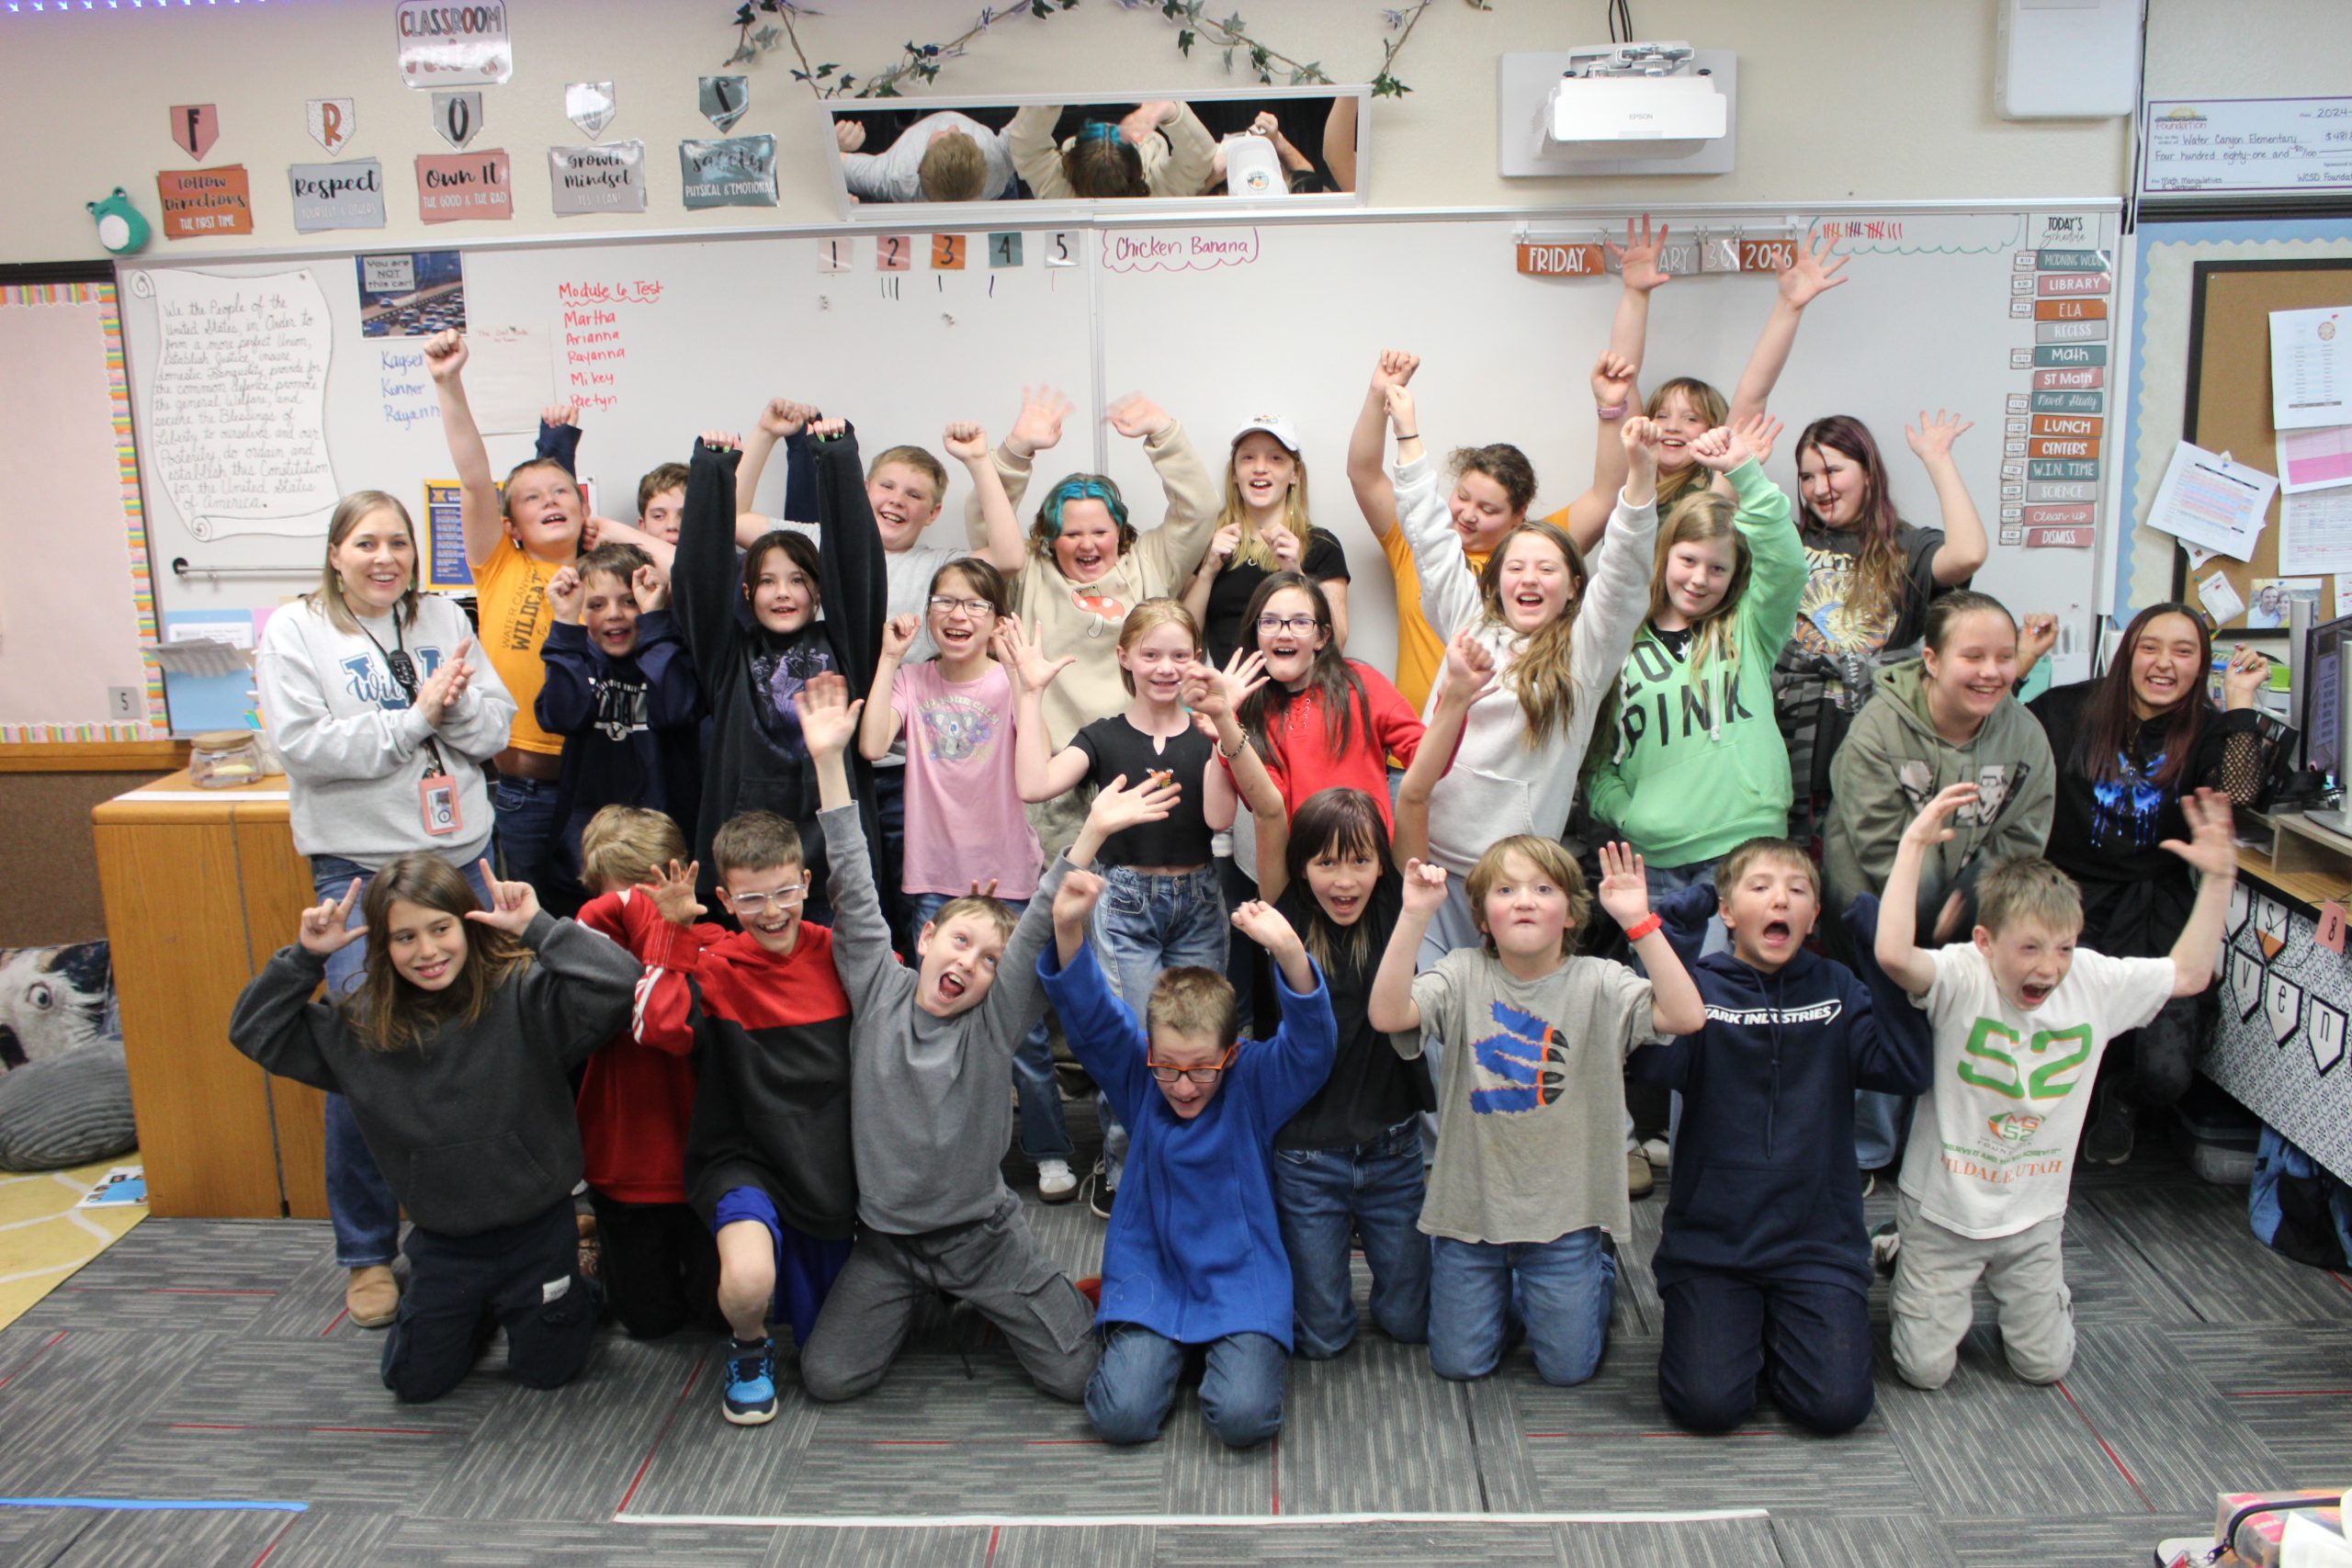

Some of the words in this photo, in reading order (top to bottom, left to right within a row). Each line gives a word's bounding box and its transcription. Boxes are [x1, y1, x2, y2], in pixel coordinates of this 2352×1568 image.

[401, 6, 502, 37] CLASSROOM
[187, 108, 200, 152] F
[322, 102, 342, 147] R
[2183, 134, 2209, 145] Water
[2215, 134, 2243, 149] Canyon
[2249, 133, 2297, 145] Elementary
[2155, 151, 2175, 161] Four
[2181, 150, 2215, 161] hundred
[2272, 150, 2290, 158] and
[294, 169, 380, 199] Respect
[426, 168, 476, 188] Own
[564, 169, 632, 189] Mindset
[2298, 173, 2320, 182] WCSD
[685, 184, 721, 197] PHYSICAL
[164, 192, 246, 212] Directions
[423, 196, 438, 209] THE
[441, 195, 461, 208] GOOD
[474, 193, 488, 206] THE
[491, 192, 506, 205] BAD
[180, 219, 195, 231] THE
[196, 216, 215, 230] FIRST
[218, 214, 235, 228] TIME
[2047, 217, 2084, 231] TODAY'S
[887, 238, 899, 266] 2
[942, 235, 954, 265] 3
[999, 236, 1011, 264] 4
[1057, 234, 1068, 260] 5
[1115, 236, 1182, 261] Chicken
[1191, 236, 1249, 255] Banana
[1529, 247, 1591, 273] FRIDAY,
[2044, 253, 2078, 266] MORNING
[378, 269, 401, 278] NOT
[368, 279, 388, 288] this
[559, 282, 609, 299] Module
[616, 282, 627, 296] 6
[633, 280, 663, 295] Test
[2049, 277, 2100, 290] LIBRARY
[163, 300, 183, 318] We
[188, 301, 206, 316] the
[210, 292, 246, 320] People
[251, 295, 264, 319] of
[270, 295, 287, 309] the
[165, 321, 199, 335] United
[246, 320, 258, 332] in
[266, 311, 296, 331] Order
[302, 308, 313, 326] to
[564, 310, 616, 329] Martha
[566, 331, 619, 345] Arianna
[2054, 323, 2092, 338] RECESS
[165, 338, 187, 351] form
[207, 341, 234, 349] more
[238, 334, 271, 355] perfect
[568, 347, 626, 366] Rayanna
[2052, 348, 2088, 361] Math
[157, 367, 201, 381] domestic
[269, 359, 304, 382] provide
[307, 359, 321, 379] for
[2043, 373, 2057, 386] ST
[2060, 372, 2092, 385] Math
[153, 382, 171, 394] the
[176, 383, 227, 394] common
[276, 380, 317, 395] promote
[153, 397, 171, 411] the
[175, 395, 221, 412] general
[2037, 396, 2064, 406] Novel
[2069, 395, 2097, 411] Study
[154, 414, 195, 426] secure
[198, 411, 217, 423] the
[220, 409, 277, 425] Blessings
[282, 408, 293, 427] of
[2043, 419, 2091, 434] LUNCH
[204, 429, 214, 440] to
[223, 442, 238, 459] do
[245, 441, 284, 458] ordain
[290, 441, 314, 456] and
[2041, 442, 2088, 456] CENTERS
[168, 462, 225, 480] establish
[232, 460, 254, 476] this
[261, 458, 328, 477] Constitution
[2068, 463, 2095, 477] TIME
[198, 482, 216, 494] the
[221, 477, 266, 495] United
[274, 478, 315, 494] States
[2041, 485, 2084, 499] SCIENCE
[2041, 530, 2075, 544] DISMISS
[502, 606, 515, 649] WATER
[1622, 671, 1754, 760] PINK
[2328, 916, 2337, 942] 8
[1705, 1008, 1742, 1024] TARK
[1957, 1016, 2093, 1100] 52
[2016, 1160, 2063, 1178] UTAH
